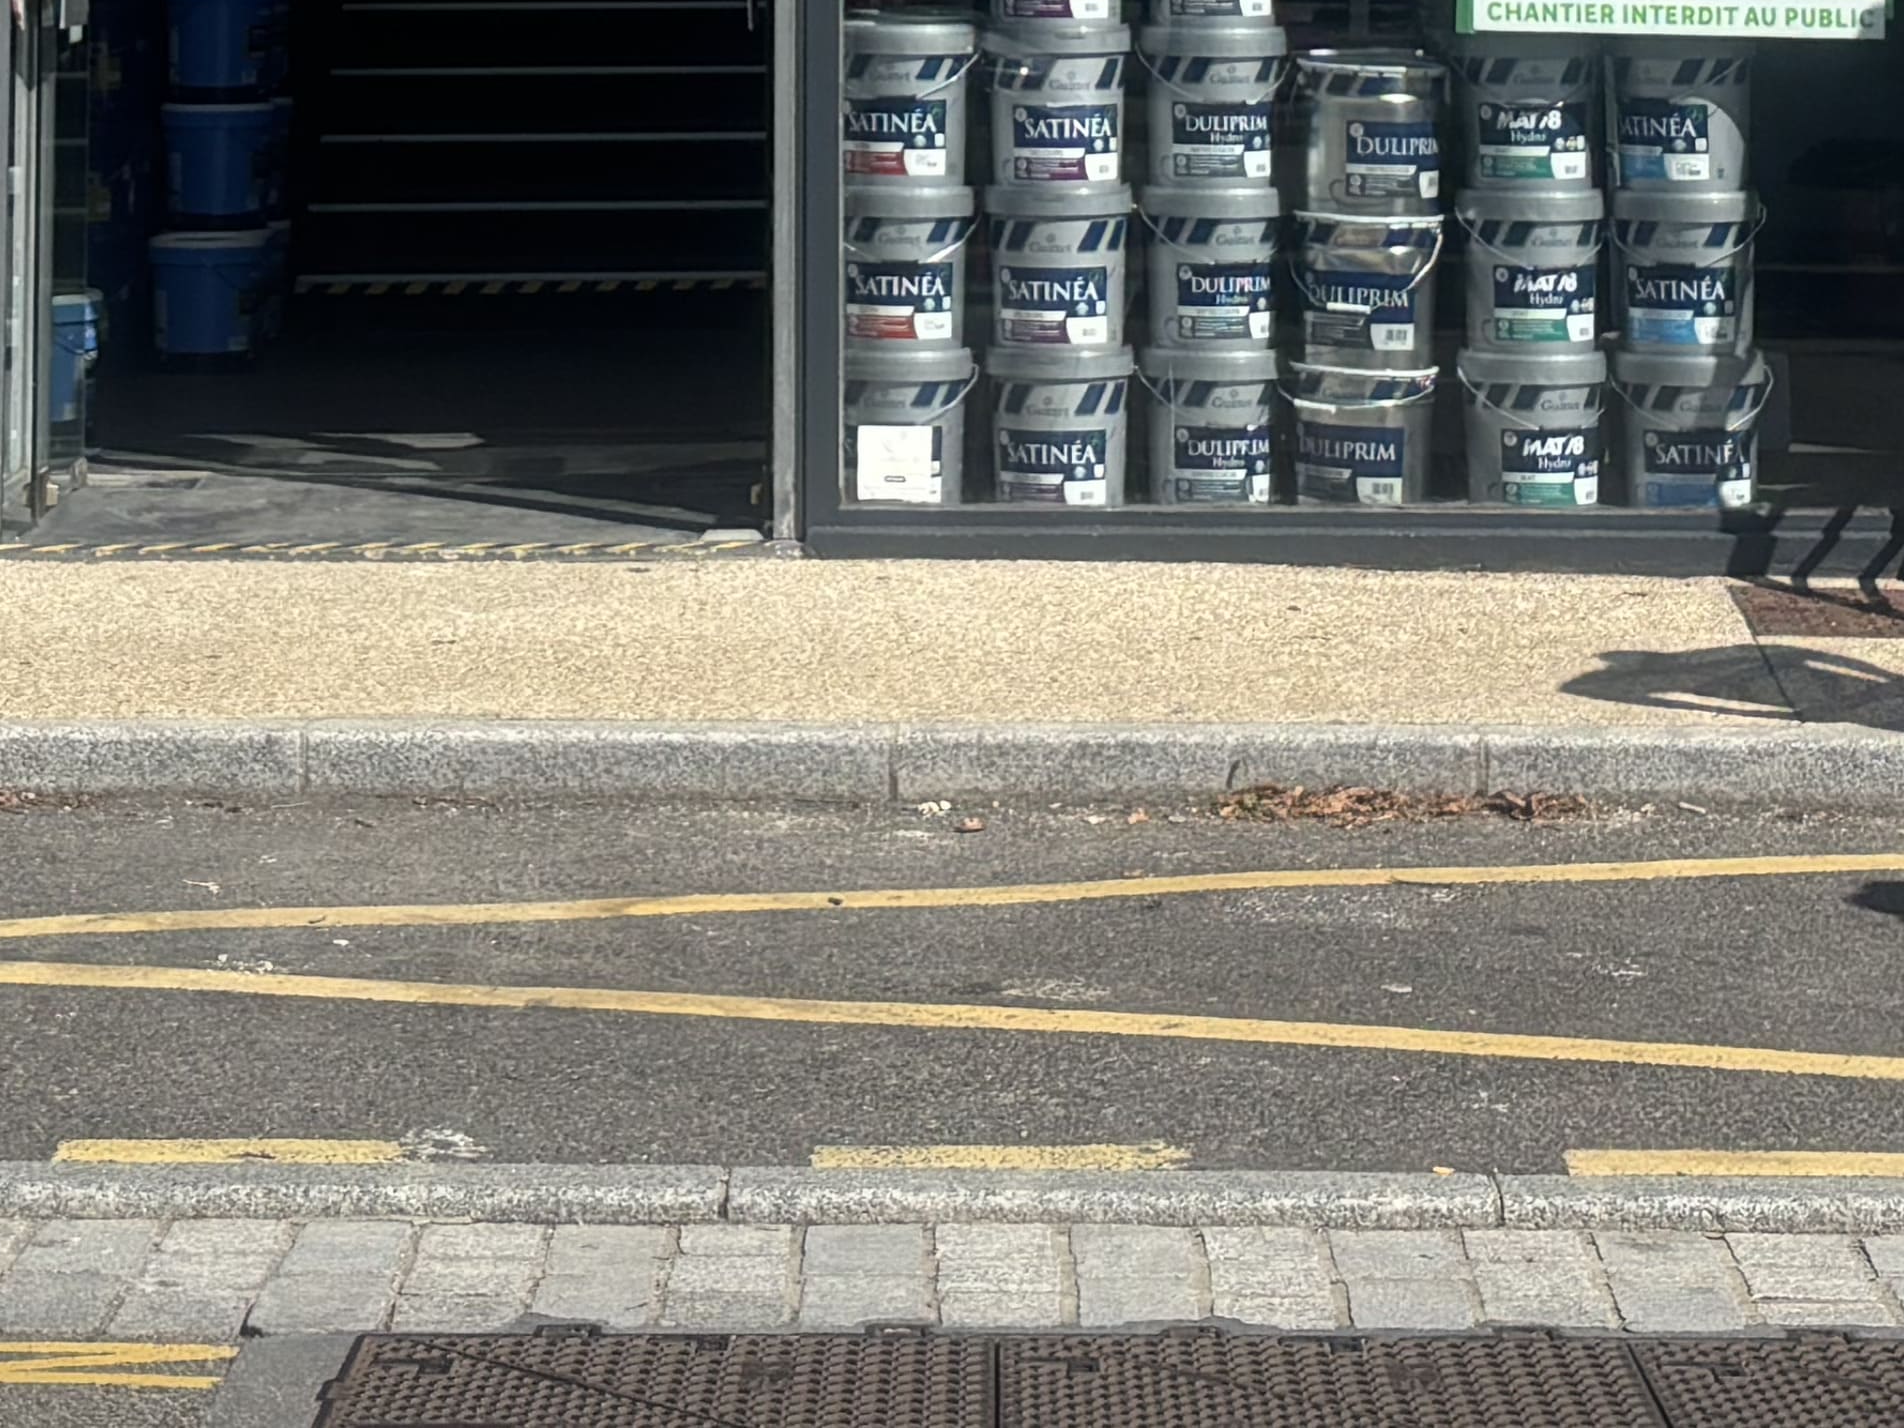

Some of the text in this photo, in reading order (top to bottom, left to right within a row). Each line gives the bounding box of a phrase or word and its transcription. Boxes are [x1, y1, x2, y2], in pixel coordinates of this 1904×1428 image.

[1487, 2, 1876, 29] CHANTIER INTERDIT AU PUBLIC
[848, 102, 938, 134] SATINÉA
[1024, 107, 1113, 139] SATINÉA
[1619, 111, 1697, 138] ATINÉA
[854, 274, 945, 298] SATINÉA
[1007, 276, 1098, 301] SATINÉA
[1634, 275, 1726, 301] SATINÉA
[1006, 439, 1097, 465] SATINÉA
